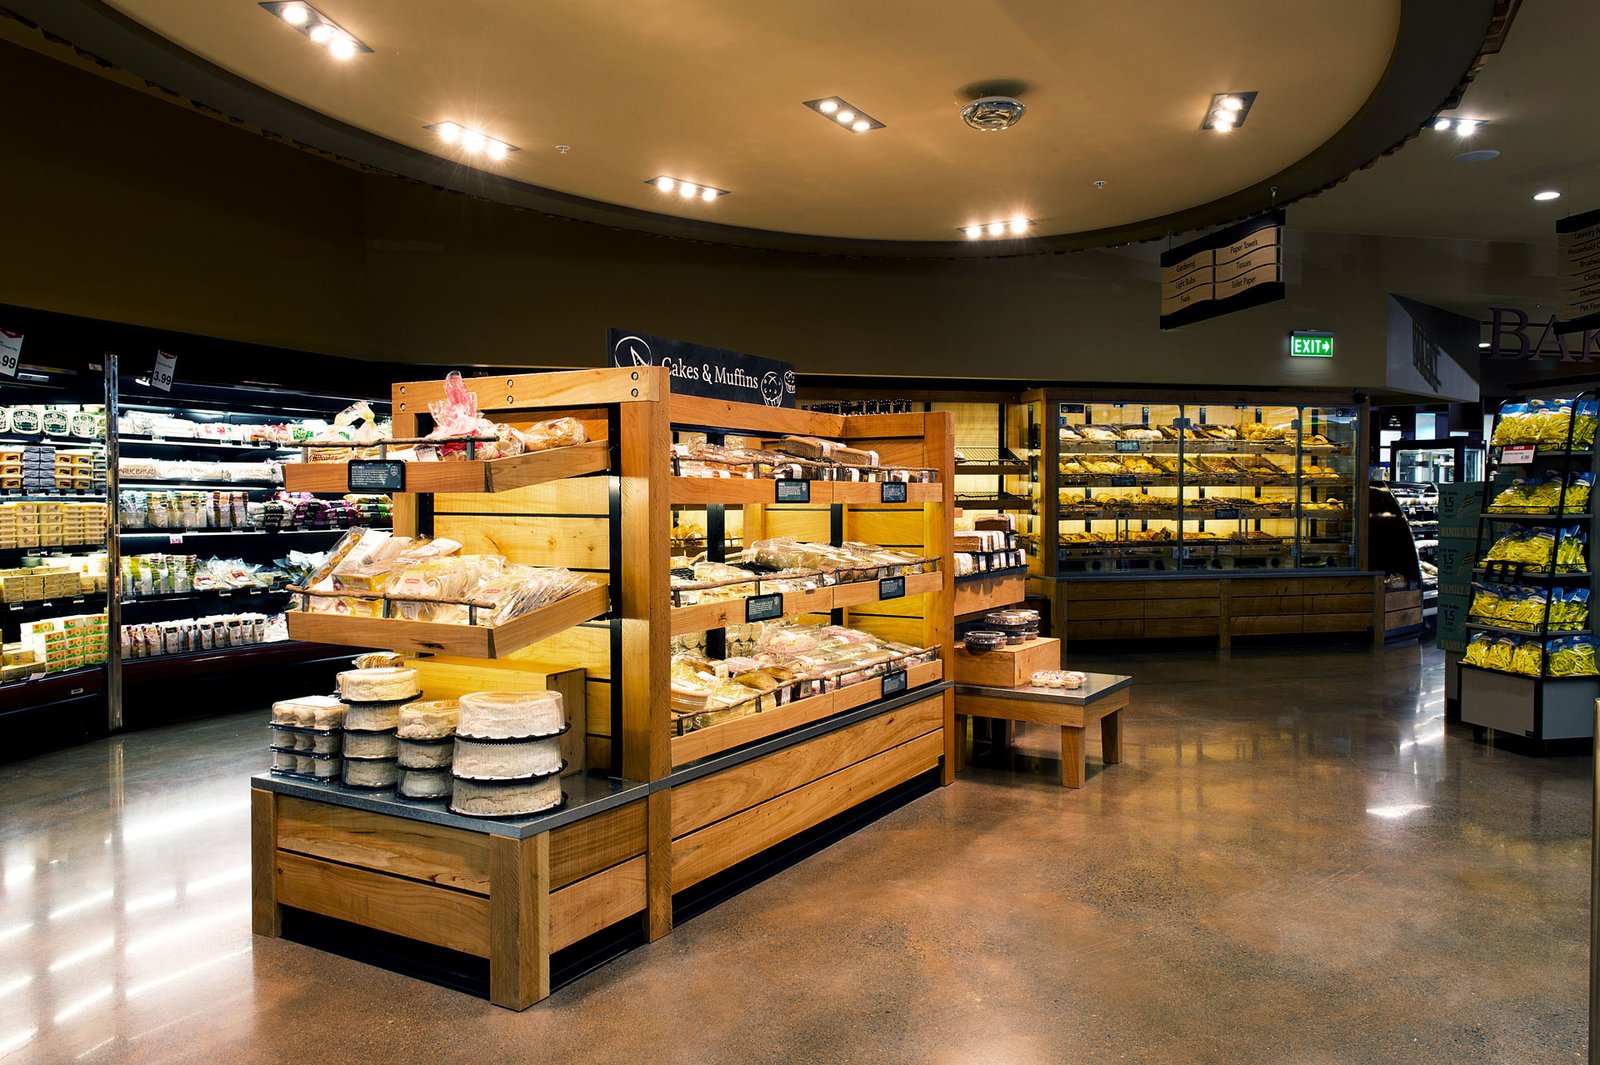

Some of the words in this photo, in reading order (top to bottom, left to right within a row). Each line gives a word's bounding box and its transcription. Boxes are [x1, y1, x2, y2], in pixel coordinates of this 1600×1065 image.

[1230, 245, 1243, 255] Paper
[1243, 238, 1258, 249] Towels
[1175, 279, 1185, 290] Light
[1185, 277, 1196, 286] Bulbs
[1231, 279, 1243, 289] Toilet
[1243, 276, 1256, 286] Paper
[1295, 339, 1322, 353] EXIT
[153, 371, 172, 386] 3.99
[661, 357, 699, 380] Cakes
[702, 363, 713, 385] &
[714, 366, 759, 389] Muffins
